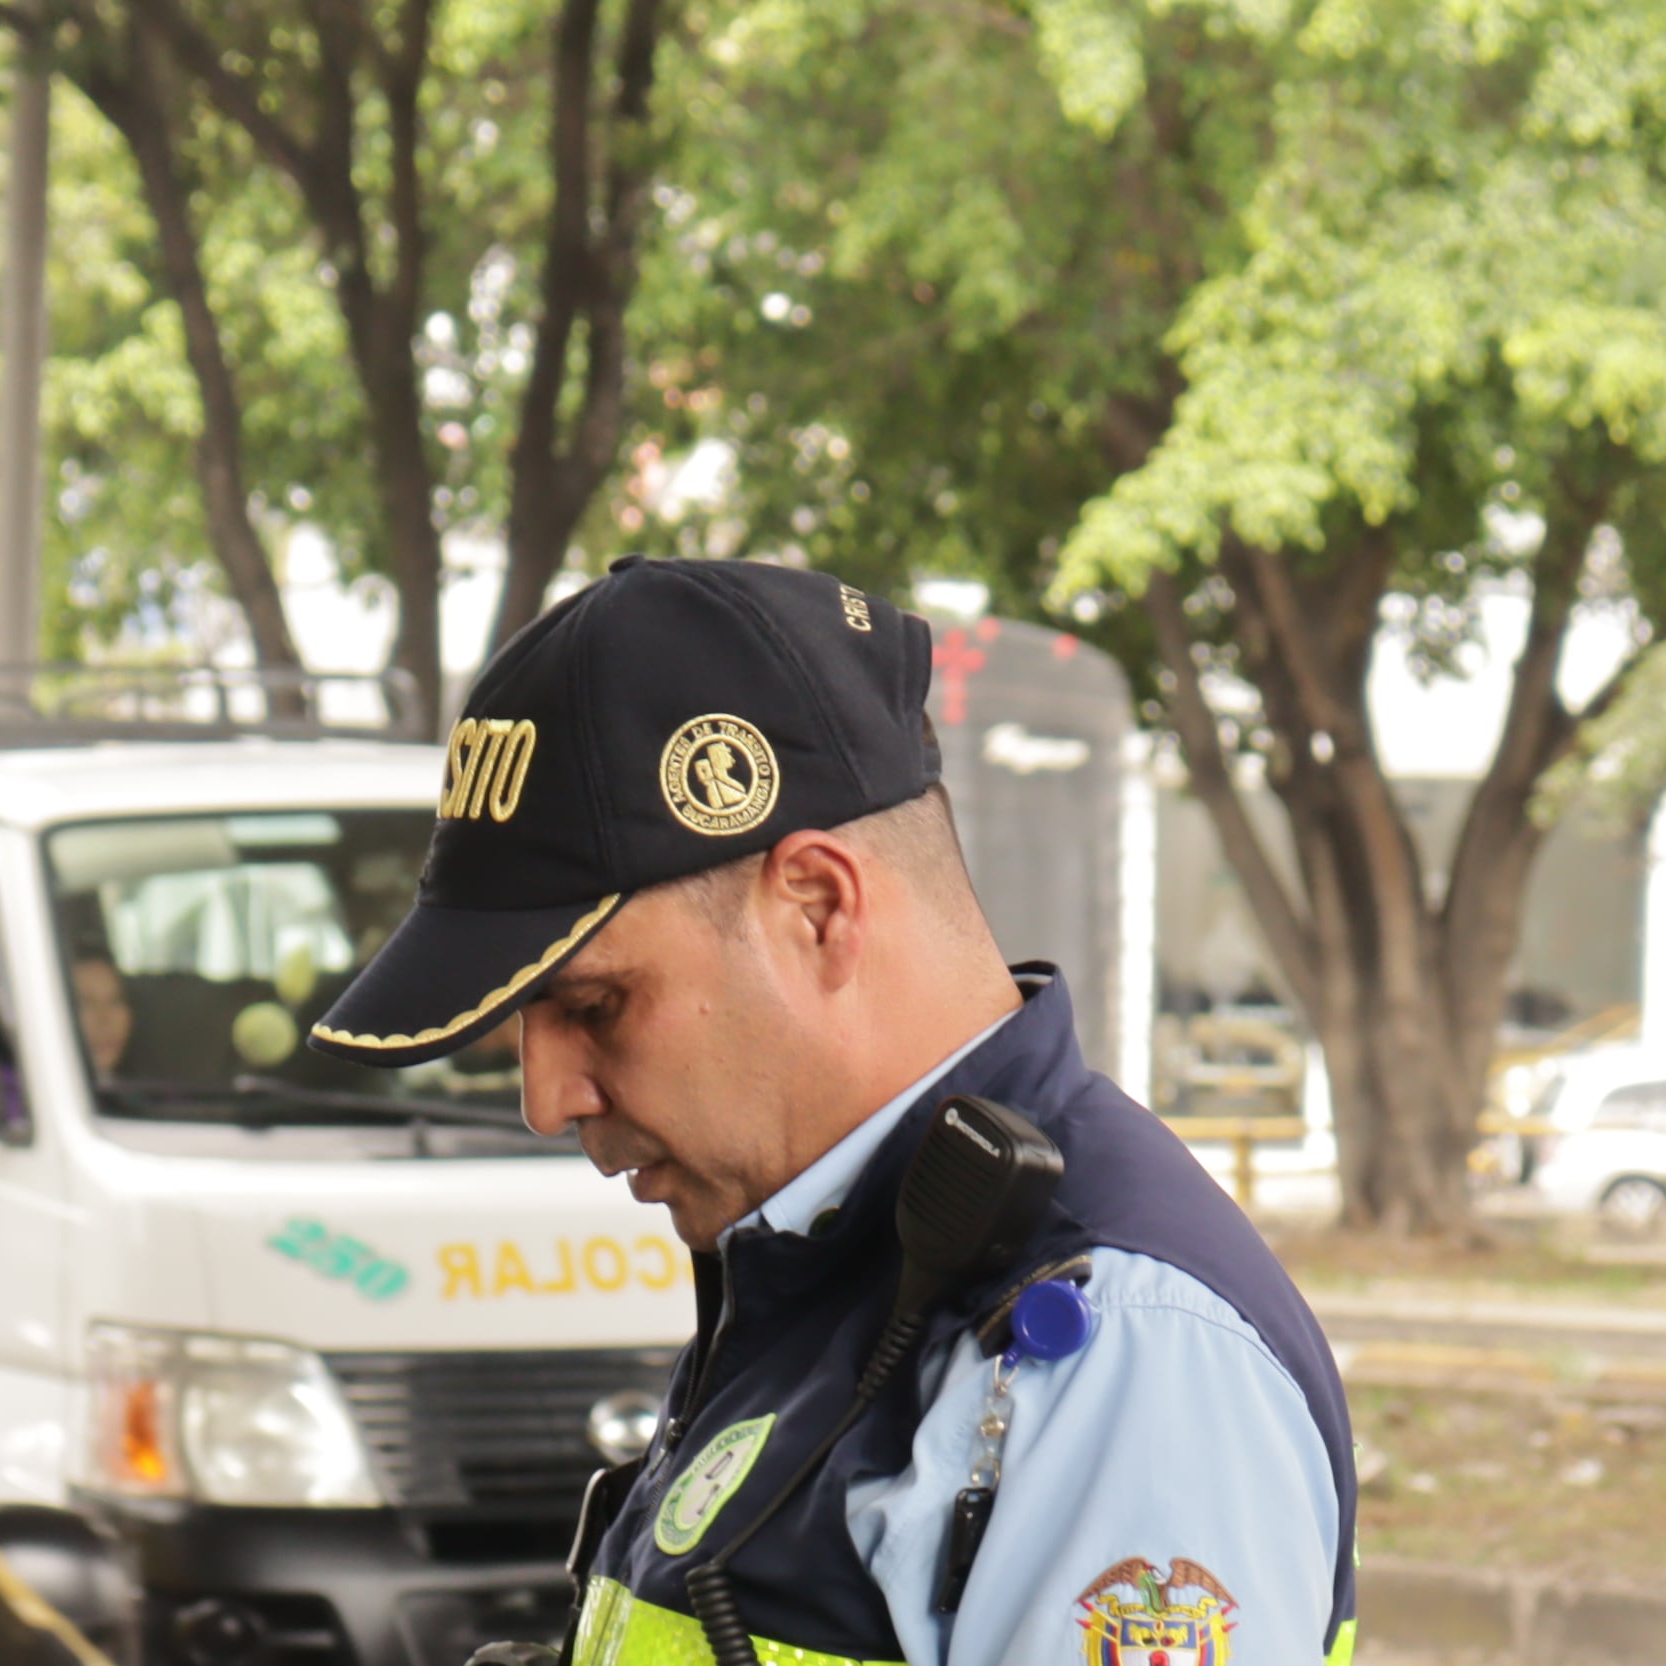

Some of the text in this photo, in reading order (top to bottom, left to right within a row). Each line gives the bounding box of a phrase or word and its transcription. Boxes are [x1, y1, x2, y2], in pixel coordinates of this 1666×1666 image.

[437, 717, 537, 822] SITO
[667, 721, 771, 803] AGENTES DE TRANSITO
[681, 778, 772, 830] BUCARAMANGA
